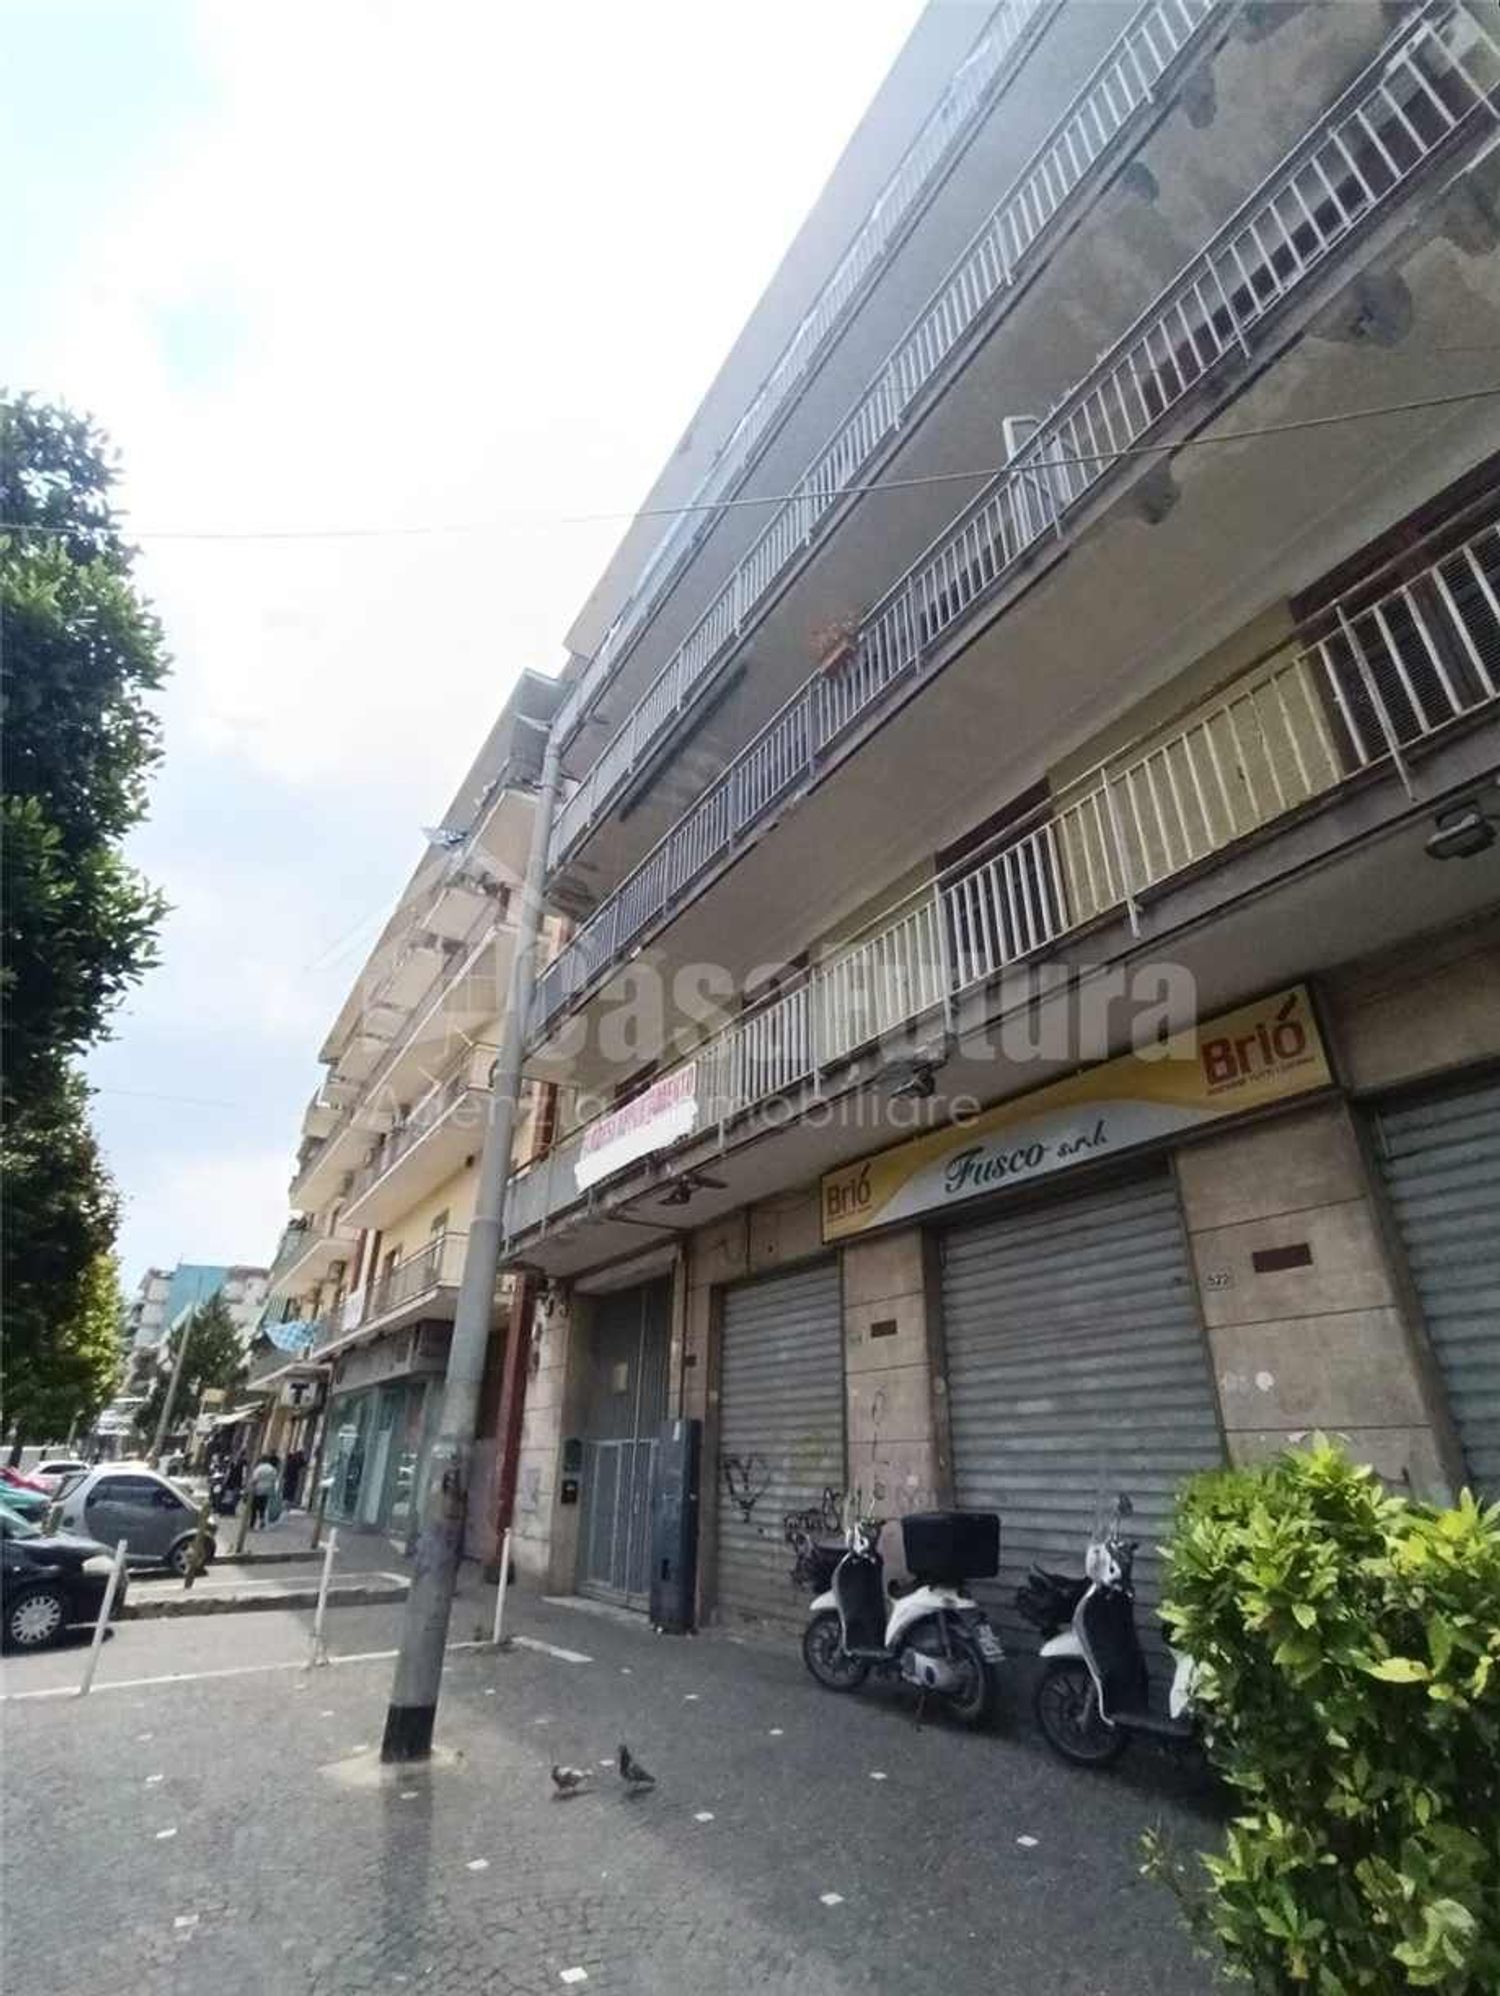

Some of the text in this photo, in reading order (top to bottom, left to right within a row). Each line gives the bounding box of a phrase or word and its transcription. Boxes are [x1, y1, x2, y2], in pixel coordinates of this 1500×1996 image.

[1200, 992, 1306, 1086] Brió
[826, 1162, 871, 1216] Brió
[944, 1143, 1048, 1194] Fusco
